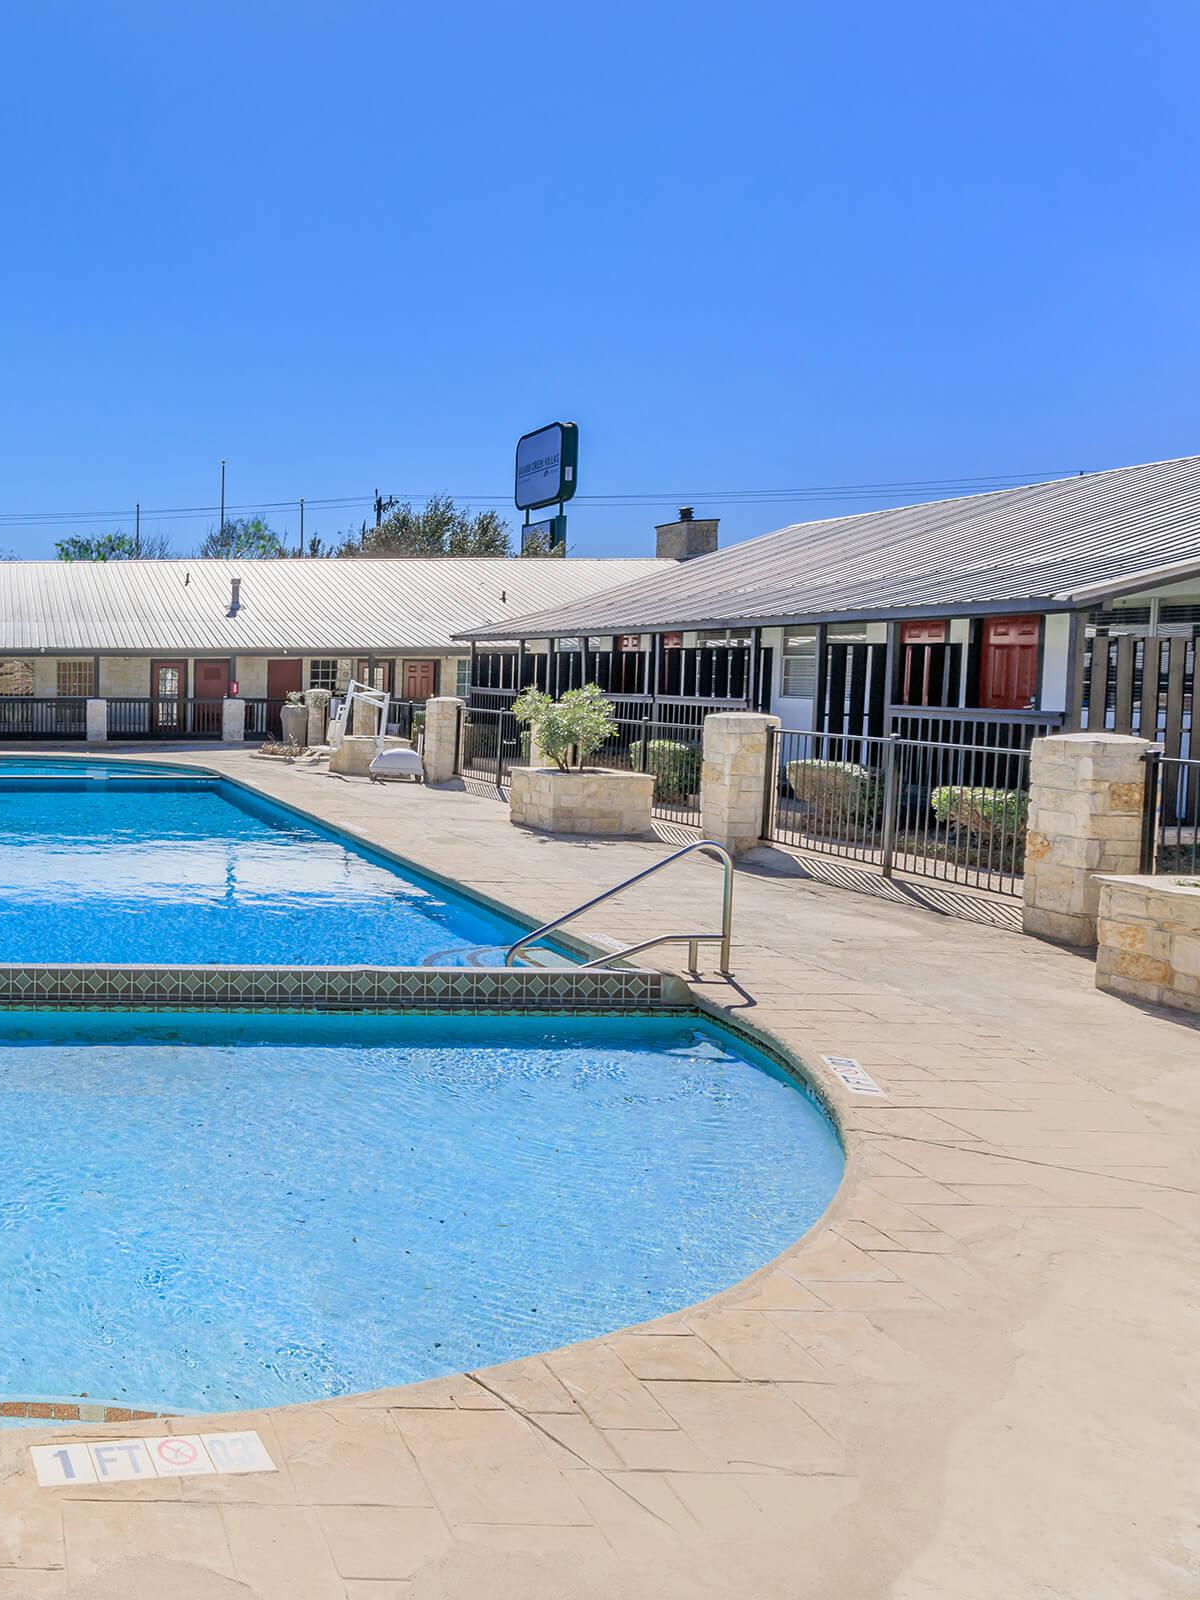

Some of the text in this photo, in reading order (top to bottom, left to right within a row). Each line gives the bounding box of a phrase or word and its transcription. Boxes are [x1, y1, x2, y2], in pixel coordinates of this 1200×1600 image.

[544, 453, 560, 466] VILLAS
[52, 1449, 76, 1479] 1
[94, 1445, 142, 1476] FT
